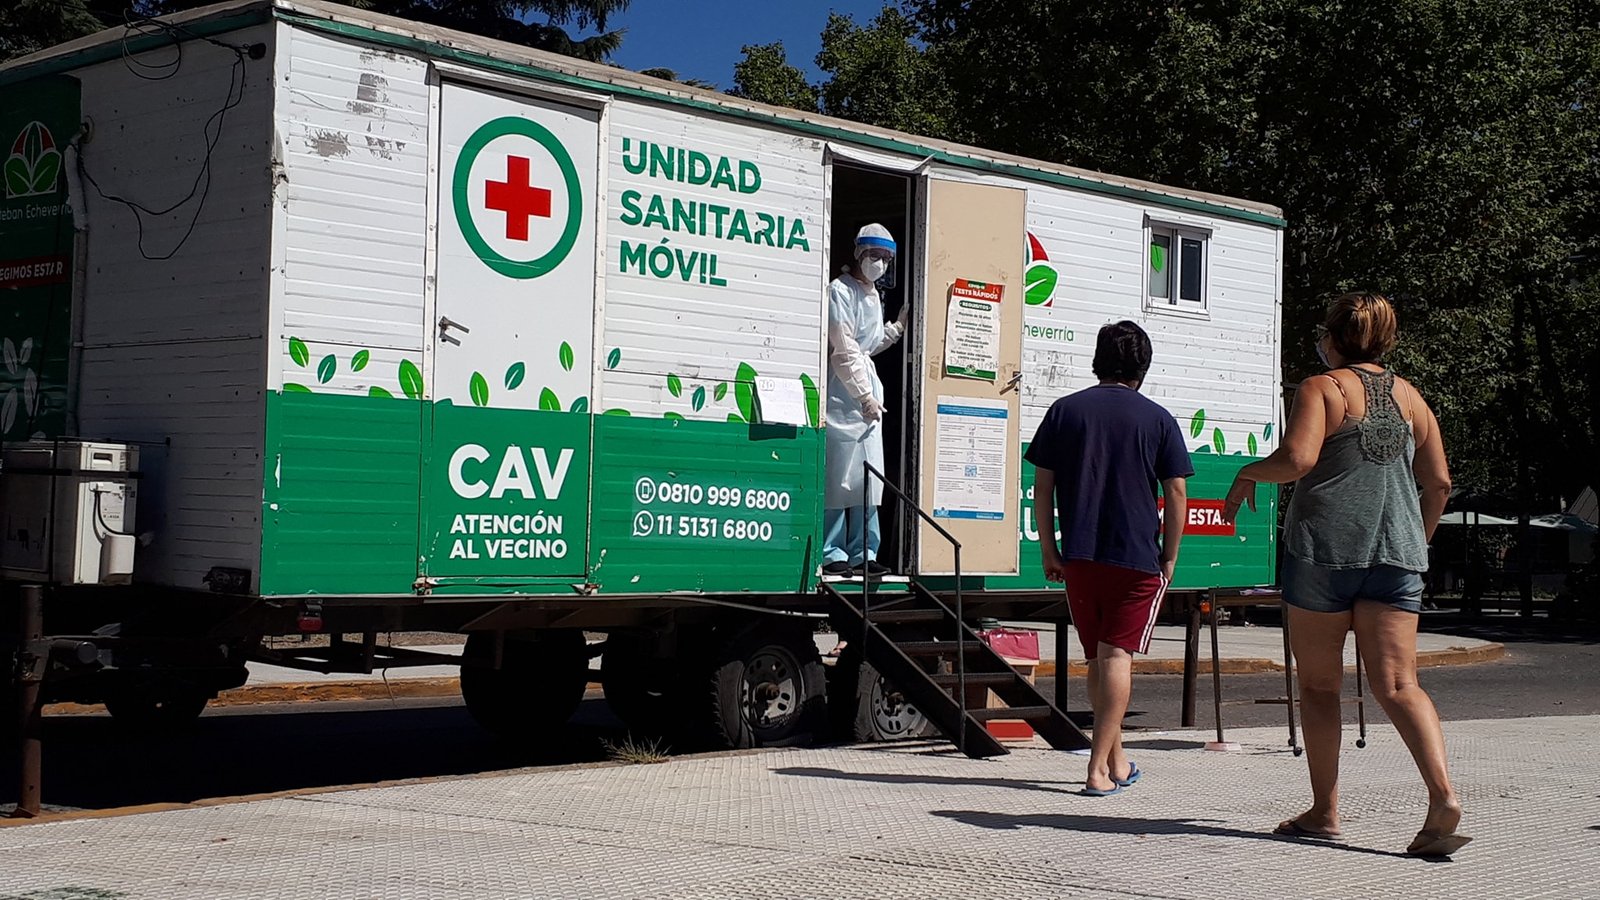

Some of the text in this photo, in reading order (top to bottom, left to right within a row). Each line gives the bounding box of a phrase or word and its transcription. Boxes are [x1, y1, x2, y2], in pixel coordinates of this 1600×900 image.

[622, 137, 762, 194] UNIDAD
[620, 189, 811, 252] SANITARIA
[619, 237, 728, 287] MÓVIL
[955, 287, 972, 295] TESTS
[448, 443, 575, 500] CAV
[658, 482, 790, 511] 0810 999 6800
[450, 509, 563, 534] ATENCIÓN
[657, 515, 772, 541] 11 5131 6800
[1188, 508, 1231, 525] ESTA
[449, 539, 567, 559] AL VECINO
